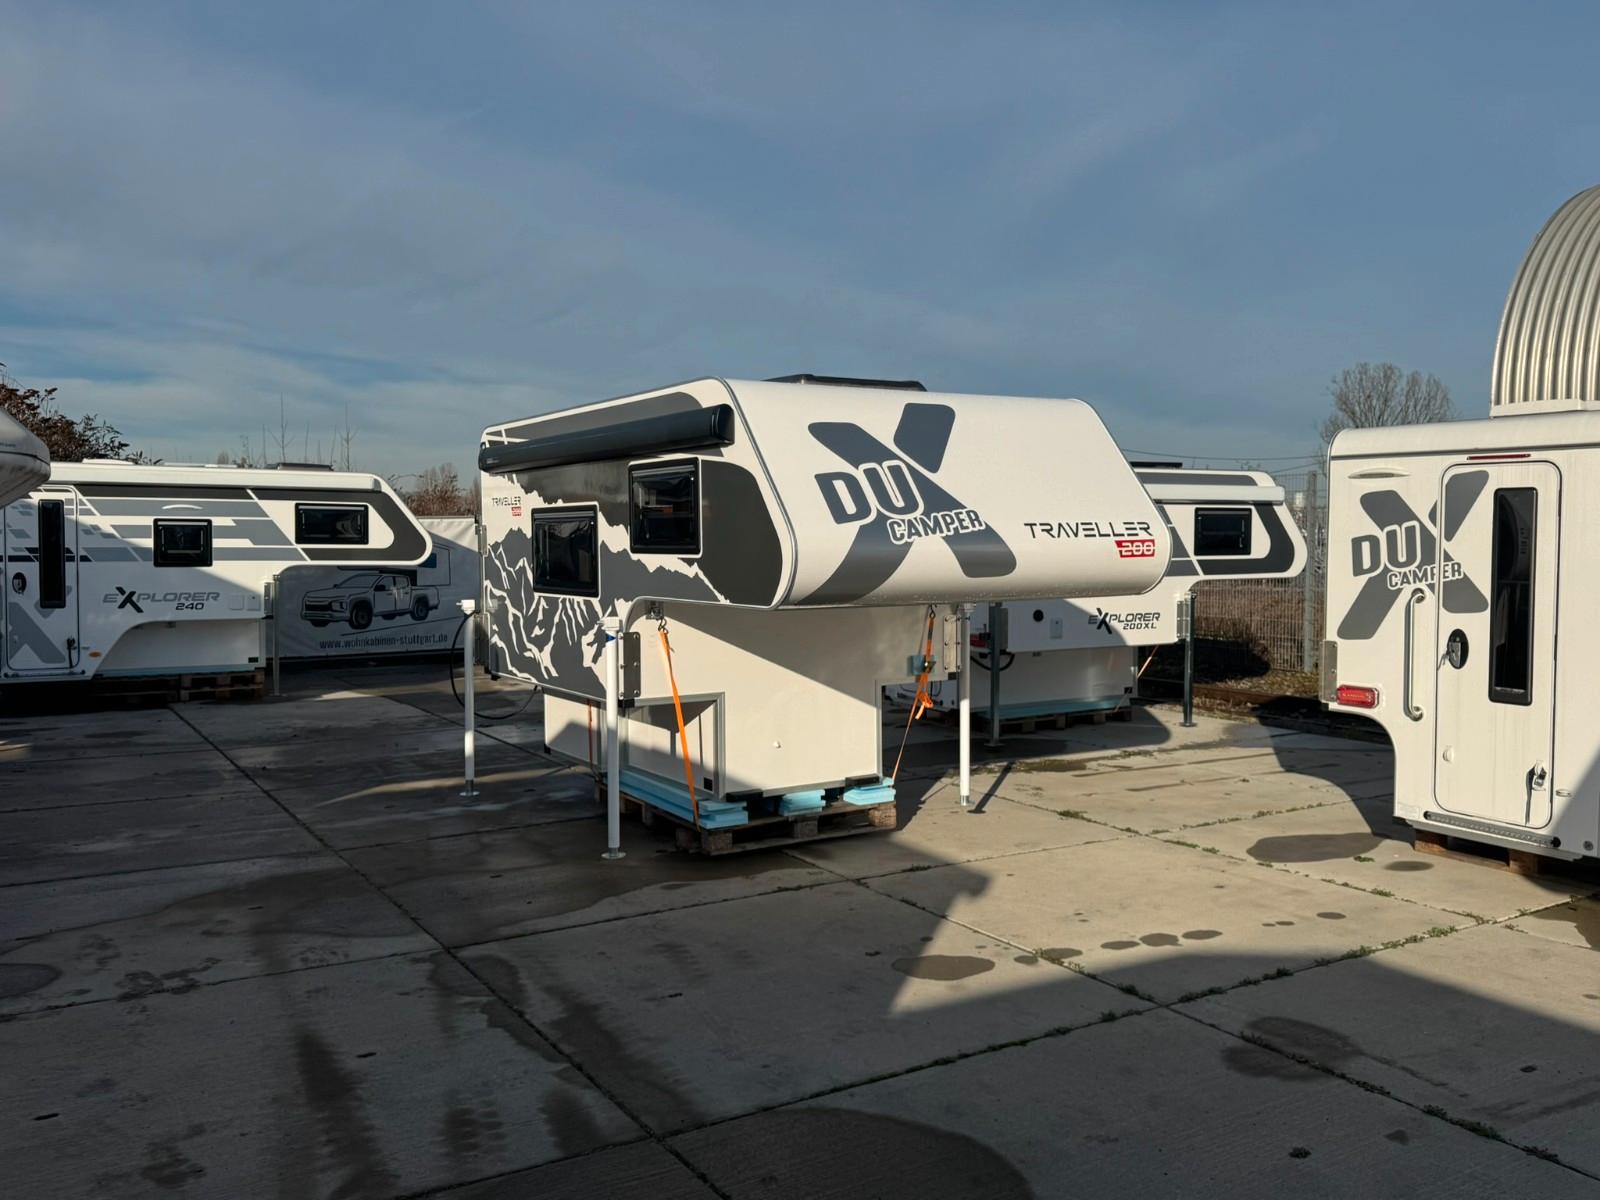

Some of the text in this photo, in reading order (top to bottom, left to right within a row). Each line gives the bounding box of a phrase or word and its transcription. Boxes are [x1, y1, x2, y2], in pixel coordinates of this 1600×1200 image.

[887, 510, 985, 544] CAMPER
[1024, 521, 1153, 538] TRAVELLER
[1119, 541, 1155, 557] 200
[175, 602, 205, 611] 240
[1122, 622, 1157, 630] 200XL
